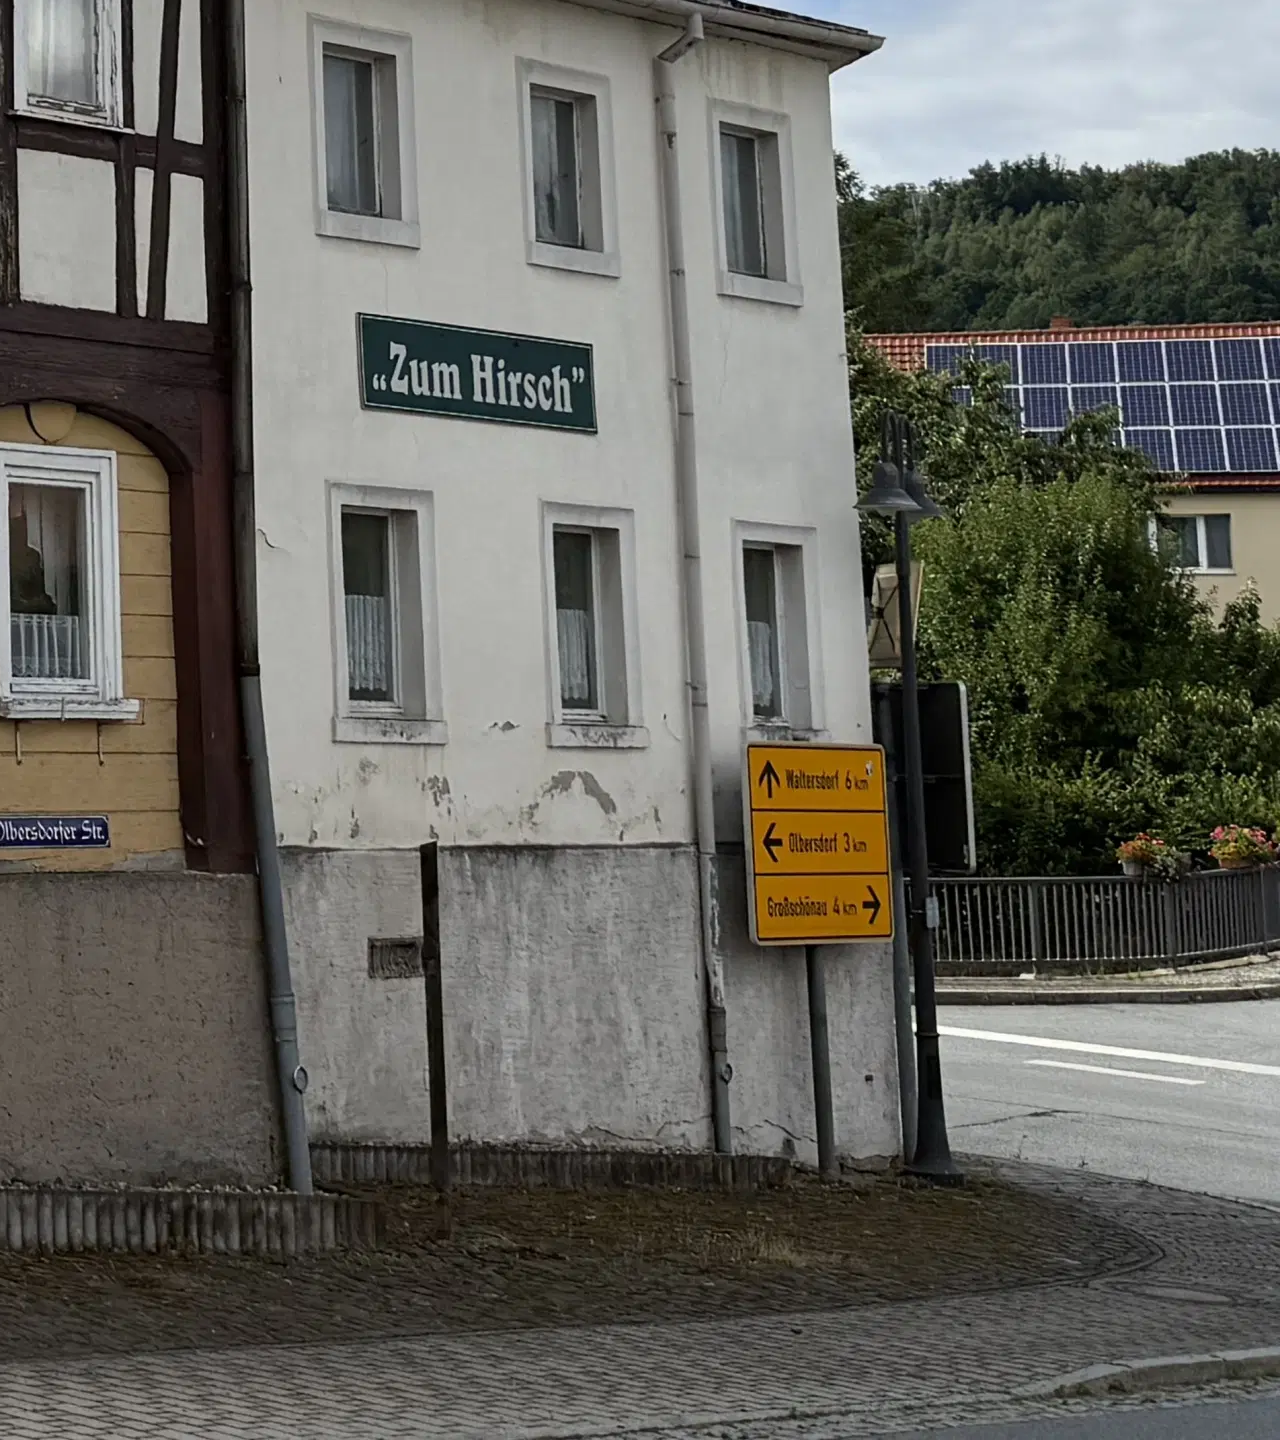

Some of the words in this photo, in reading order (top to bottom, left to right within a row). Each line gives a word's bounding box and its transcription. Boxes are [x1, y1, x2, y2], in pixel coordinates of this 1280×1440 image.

[785, 769, 839, 791] Waltersdorf
[845, 769, 852, 791] 6
[854, 775, 869, 790] km
[81, 820, 105, 840] Str.
[789, 832, 837, 853] Olbersdorf
[843, 833, 851, 853] 3
[853, 839, 867, 852] km
[767, 896, 828, 917] Großschönau
[833, 896, 840, 916] 4
[843, 901, 858, 916] km
